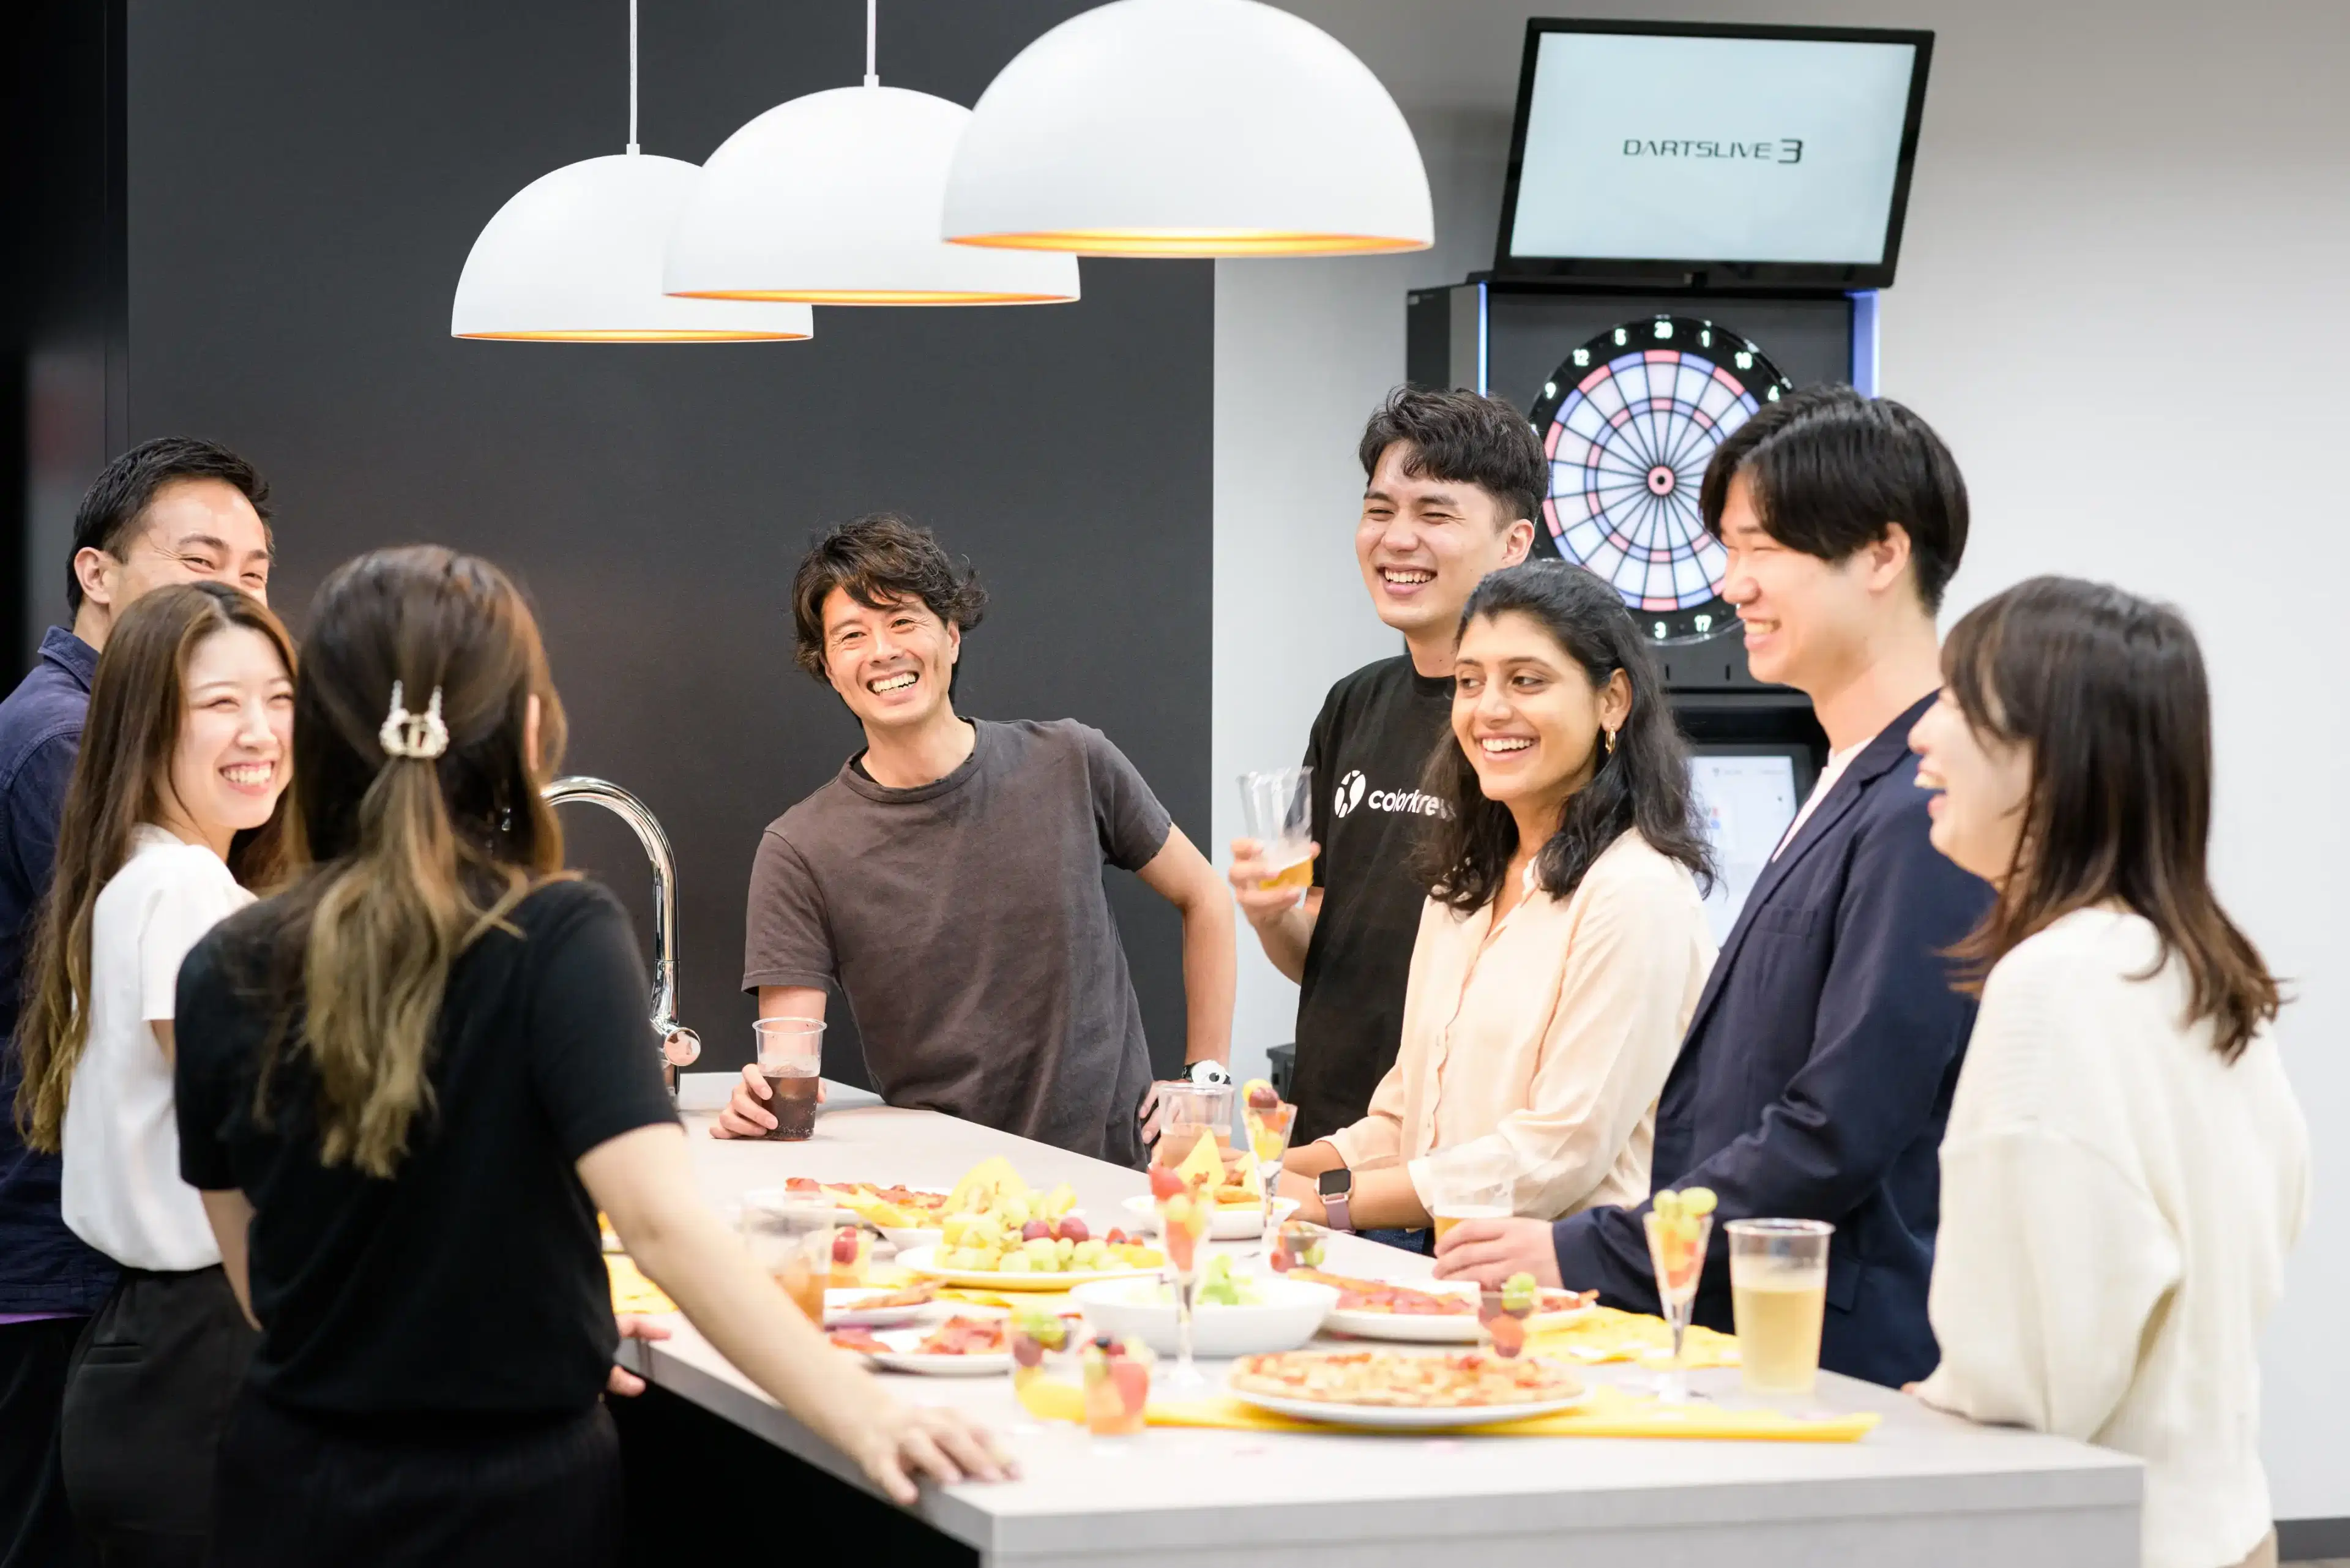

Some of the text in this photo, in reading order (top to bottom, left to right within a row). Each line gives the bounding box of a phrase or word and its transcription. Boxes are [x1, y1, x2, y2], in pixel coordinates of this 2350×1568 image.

[1622, 138, 1804, 164] DARTSLIVE 3
[1614, 328, 1627, 346] 5
[1654, 321, 1673, 339] 20
[1701, 330, 1710, 348] 1
[1572, 348, 1590, 367] 12
[1545, 381, 1557, 399] 9
[1767, 384, 1780, 402] 4
[1654, 621, 1666, 639] 3
[1694, 614, 1712, 632] 17
